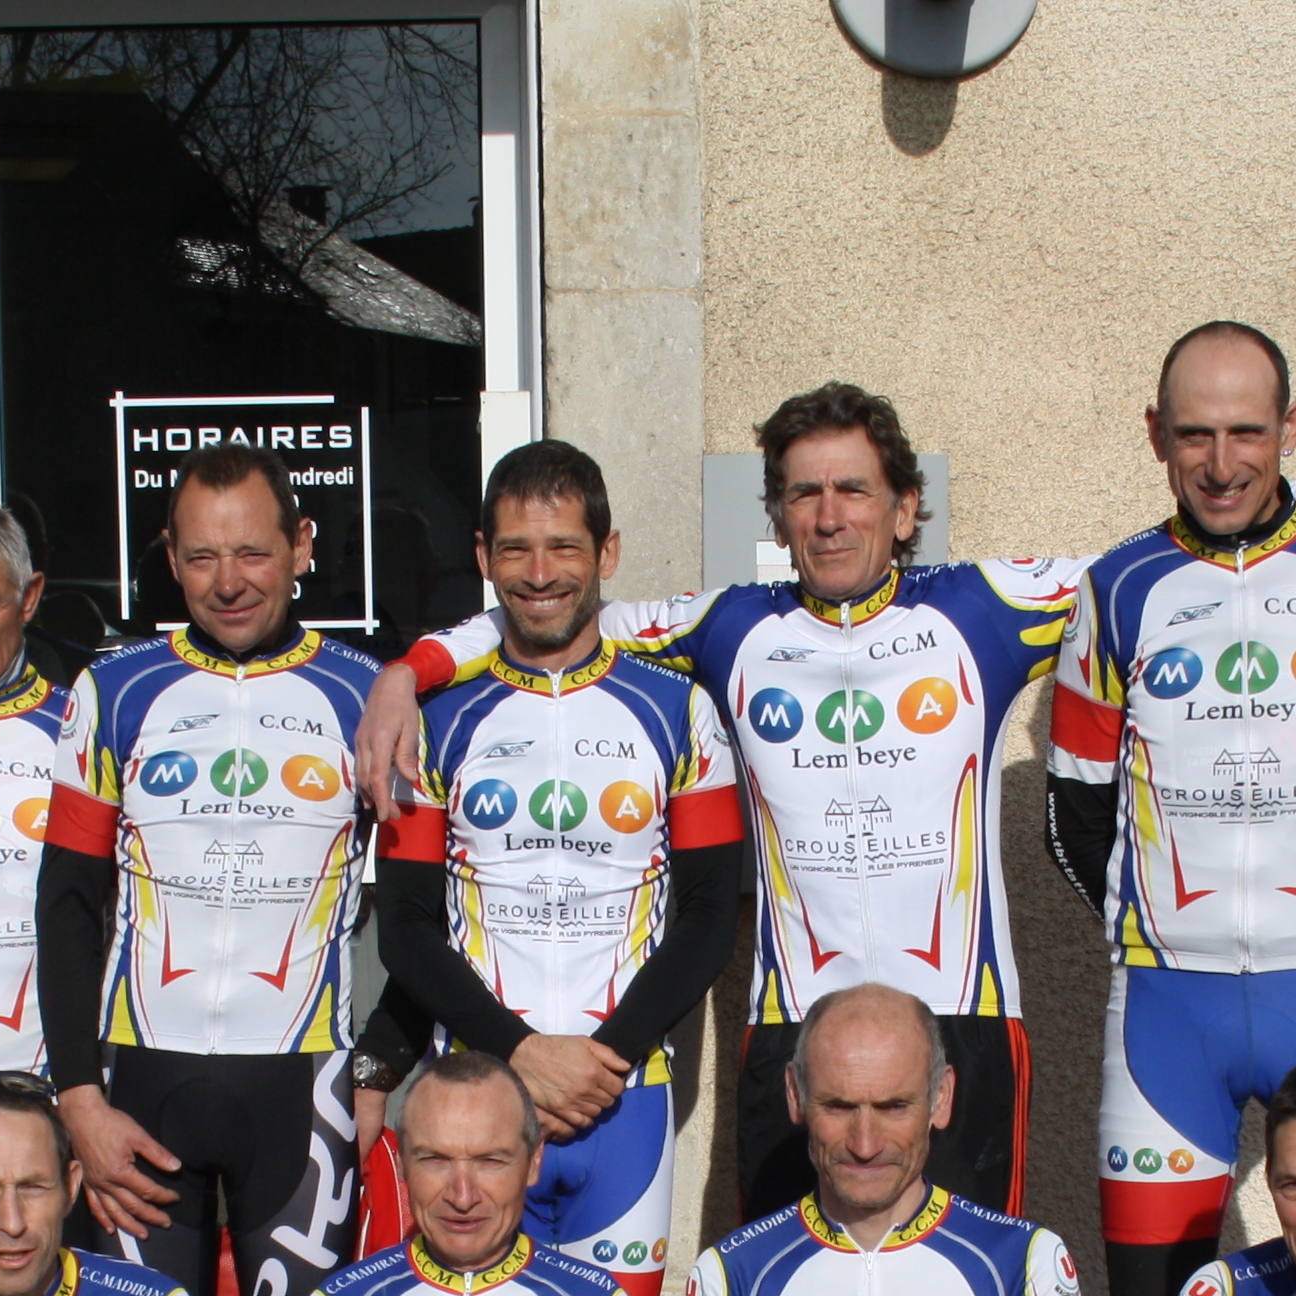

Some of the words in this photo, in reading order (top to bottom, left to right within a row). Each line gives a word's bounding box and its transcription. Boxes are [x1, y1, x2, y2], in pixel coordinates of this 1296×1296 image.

[133, 425, 353, 452] HORAIRES
[134, 470, 162, 488] Du
[290, 467, 353, 486] ndredi
[90, 636, 168, 669] C.C.MADIRAN
[175, 640, 218, 670] C.C.M
[267, 642, 316, 670] C.C.M
[869, 630, 938, 660] C.C.M
[571, 652, 613, 685] C.C.M
[260, 714, 324, 736] C.C.M
[575, 739, 637, 759] C.C.M
[791, 745, 917, 769] Lembeye
[180, 799, 295, 818] Lembeye
[504, 833, 612, 857] Lembeye
[785, 830, 946, 854] CROUSEILLES
[487, 903, 626, 919] CROUSEILLES
[720, 1204, 799, 1255] C.C.MADIRAN
[804, 1203, 840, 1245] C.C.M
[326, 1250, 406, 1295] C.C.MADIRAN
[415, 1249, 454, 1286] C.C.M
[482, 1247, 528, 1285] C.C.M
[535, 1250, 615, 1291] C.C.MADIRAN
